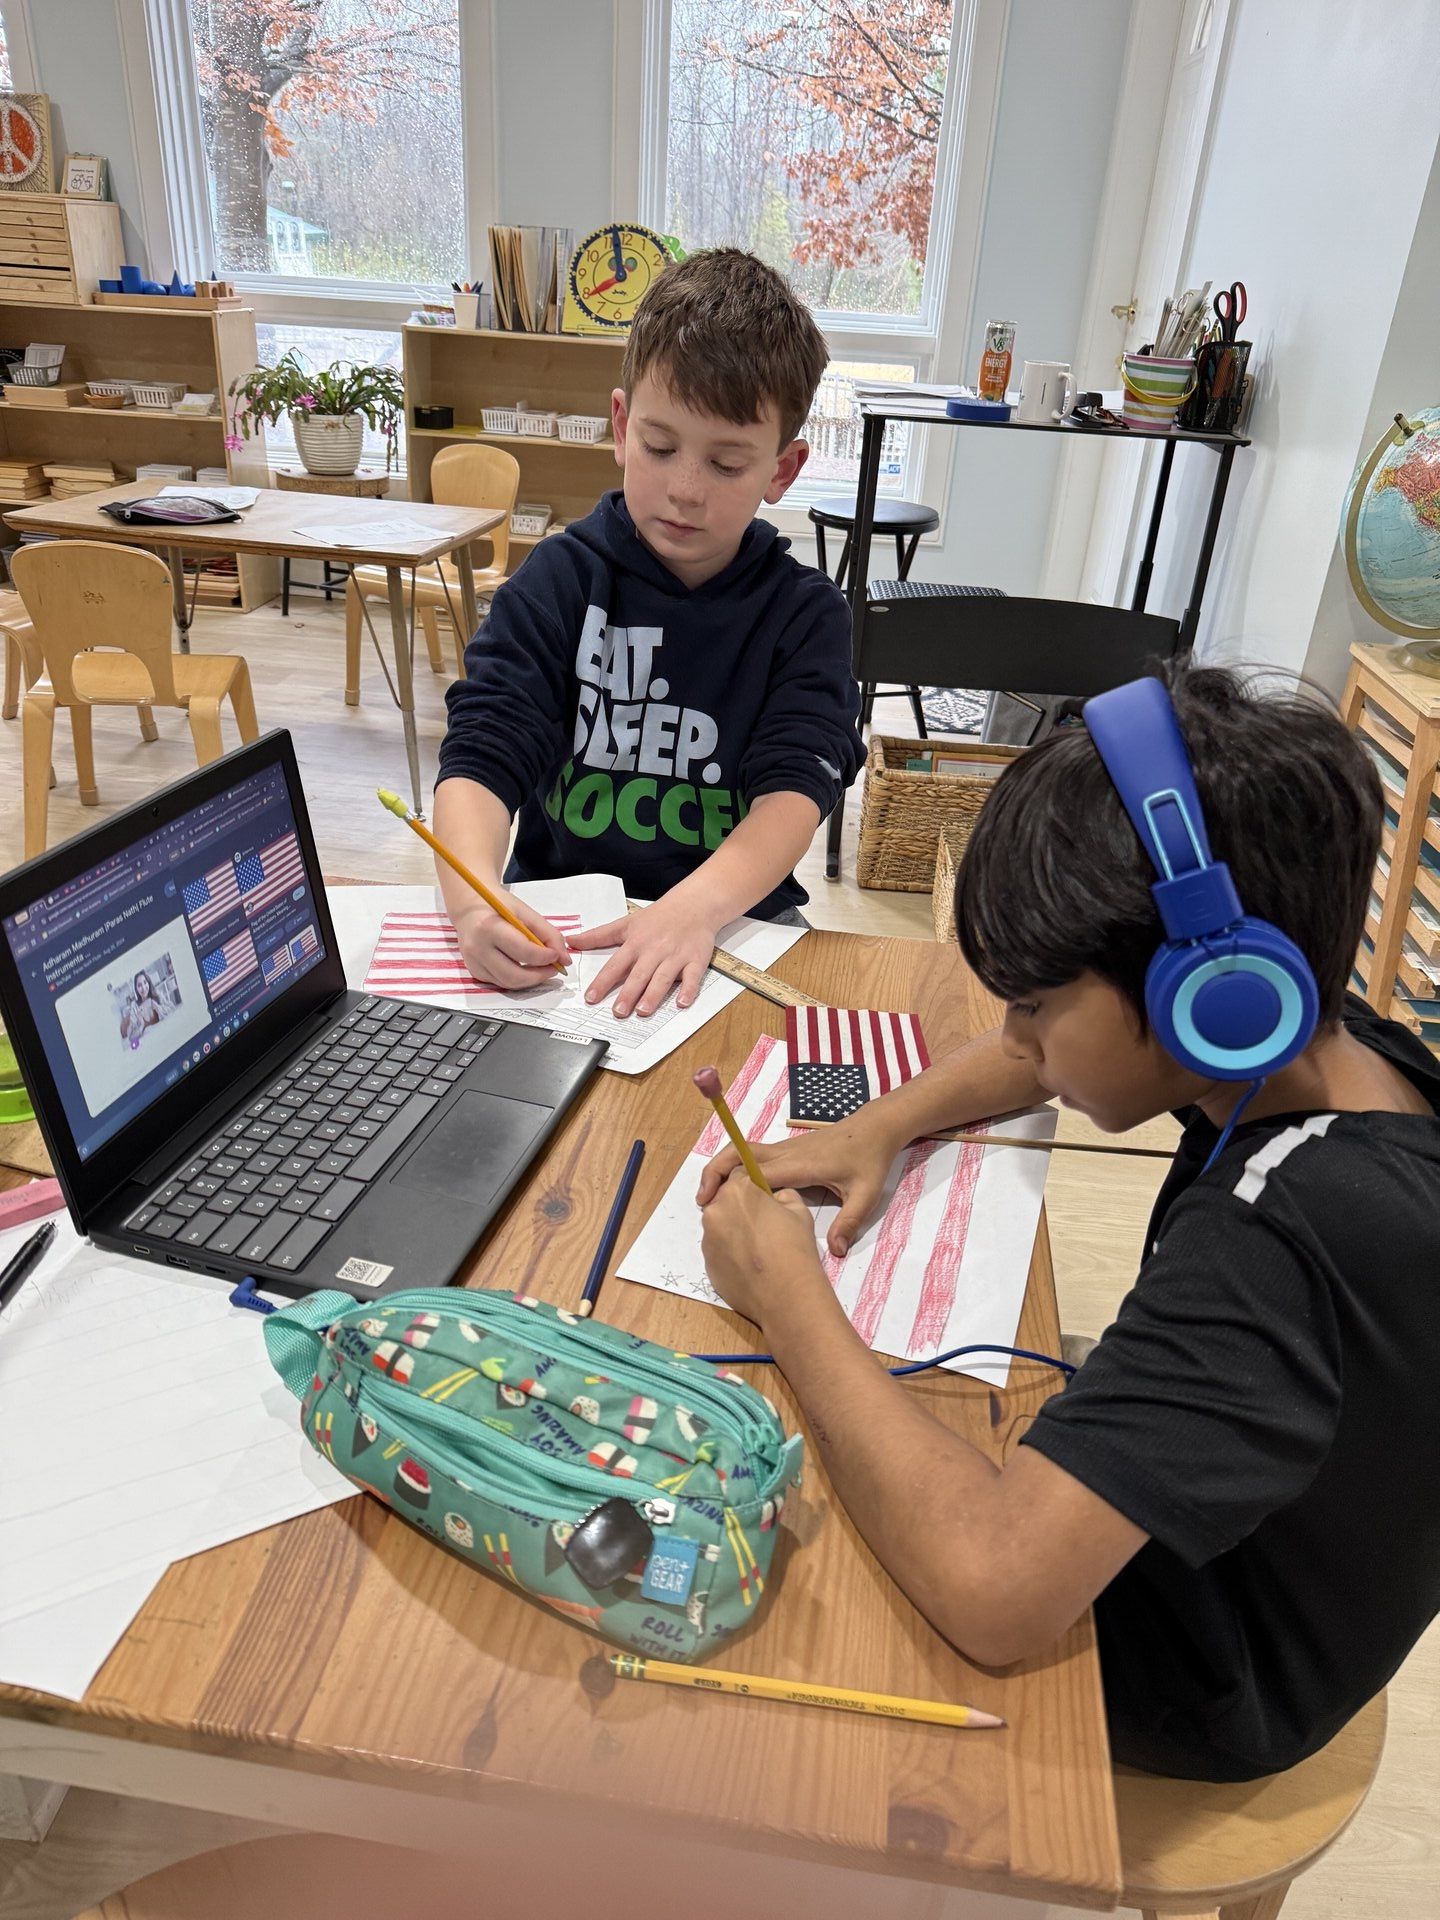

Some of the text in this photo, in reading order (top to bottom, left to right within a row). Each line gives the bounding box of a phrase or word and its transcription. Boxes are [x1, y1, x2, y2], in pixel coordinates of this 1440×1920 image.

[621, 232, 633, 246] 12
[586, 250, 600, 262] 10
[653, 253, 662, 266] 2
[578, 268, 586, 280] 9
[582, 286, 590, 300] 8
[596, 302, 606, 314] 7
[613, 308, 622, 320] 6
[985, 357, 1008, 368] ENERGY
[575, 604, 670, 701] EAT.
[574, 684, 722, 785] SLEEP.
[545, 758, 749, 852] SOCCE
[553, 1032, 589, 1044] Lenovo
[530, 1404, 587, 1456] AMAZING
[652, 1554, 690, 1573] pen+
[650, 1569, 686, 1593] GEAR
[641, 1616, 684, 1642] ROLL
